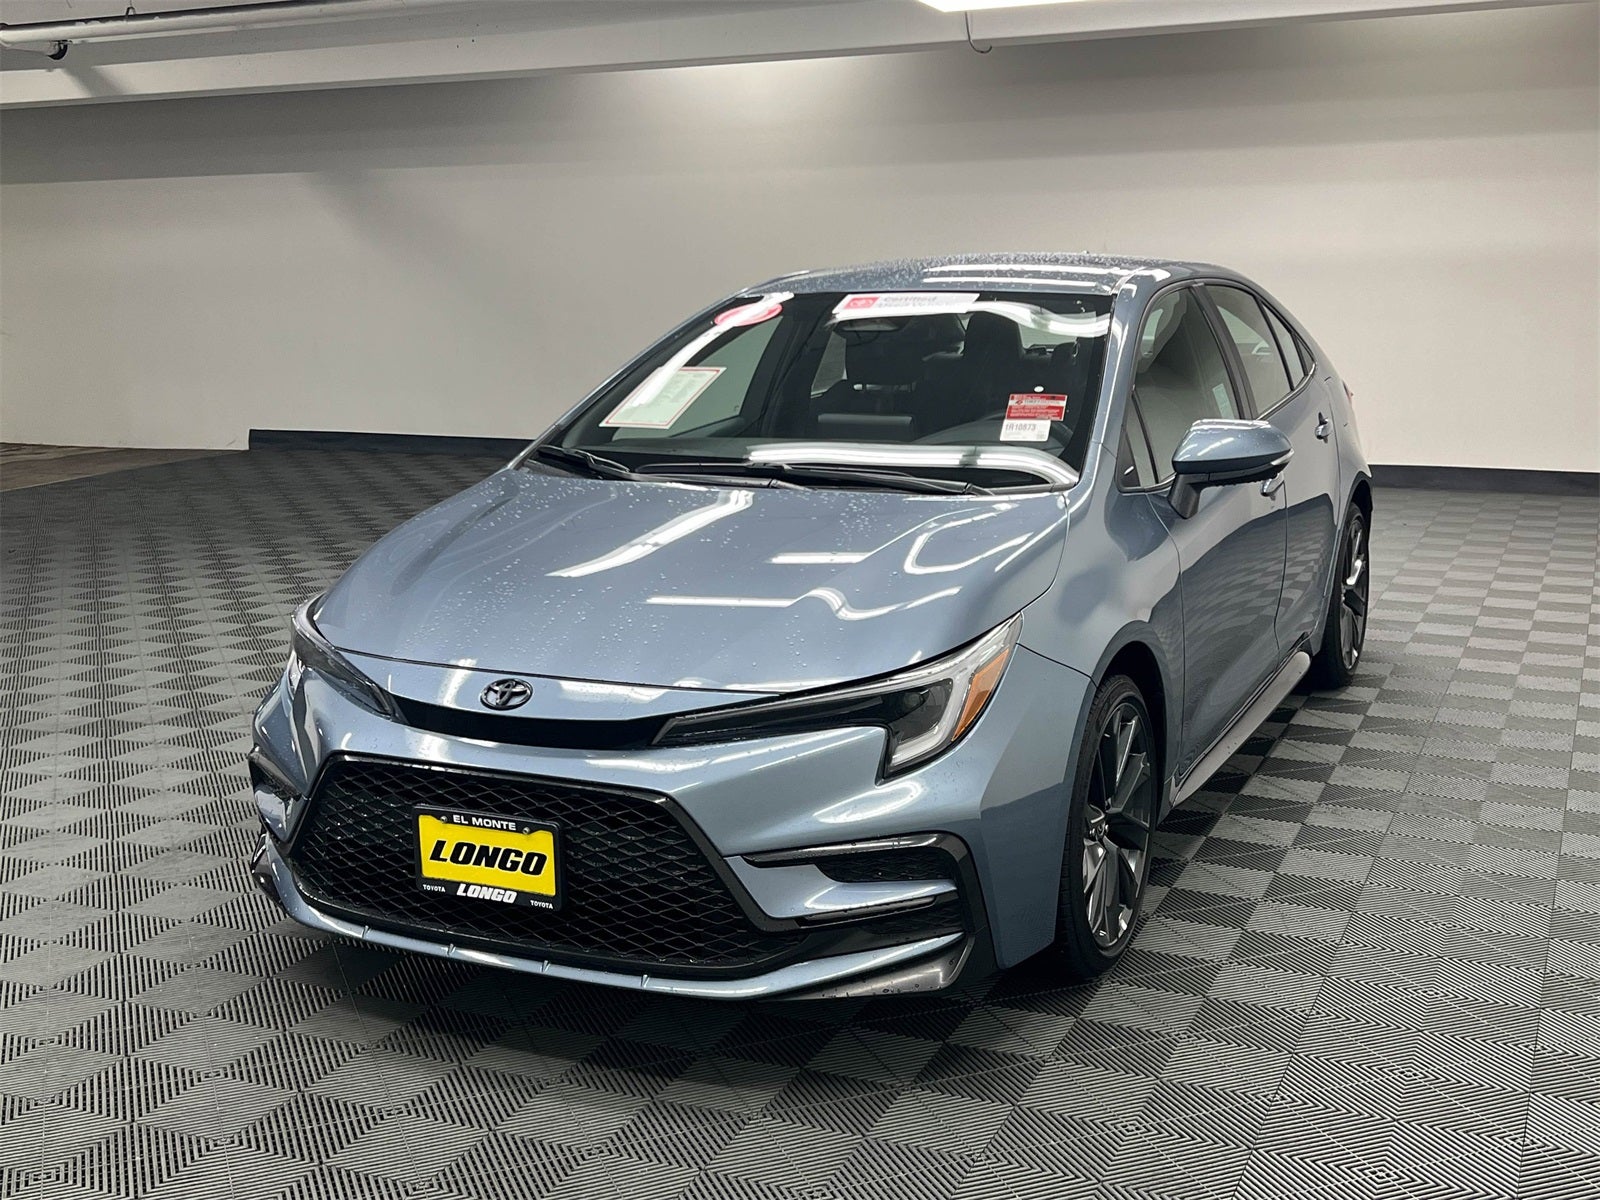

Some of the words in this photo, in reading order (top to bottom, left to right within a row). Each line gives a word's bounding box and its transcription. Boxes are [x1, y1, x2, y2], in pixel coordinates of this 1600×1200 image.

[453, 815, 469, 825] EL
[472, 817, 517, 831] MONTE
[429, 839, 548, 876] LONGO
[423, 884, 446, 893] TOYOTA
[456, 883, 518, 904] LONGO
[530, 900, 554, 910] TOYOTA
